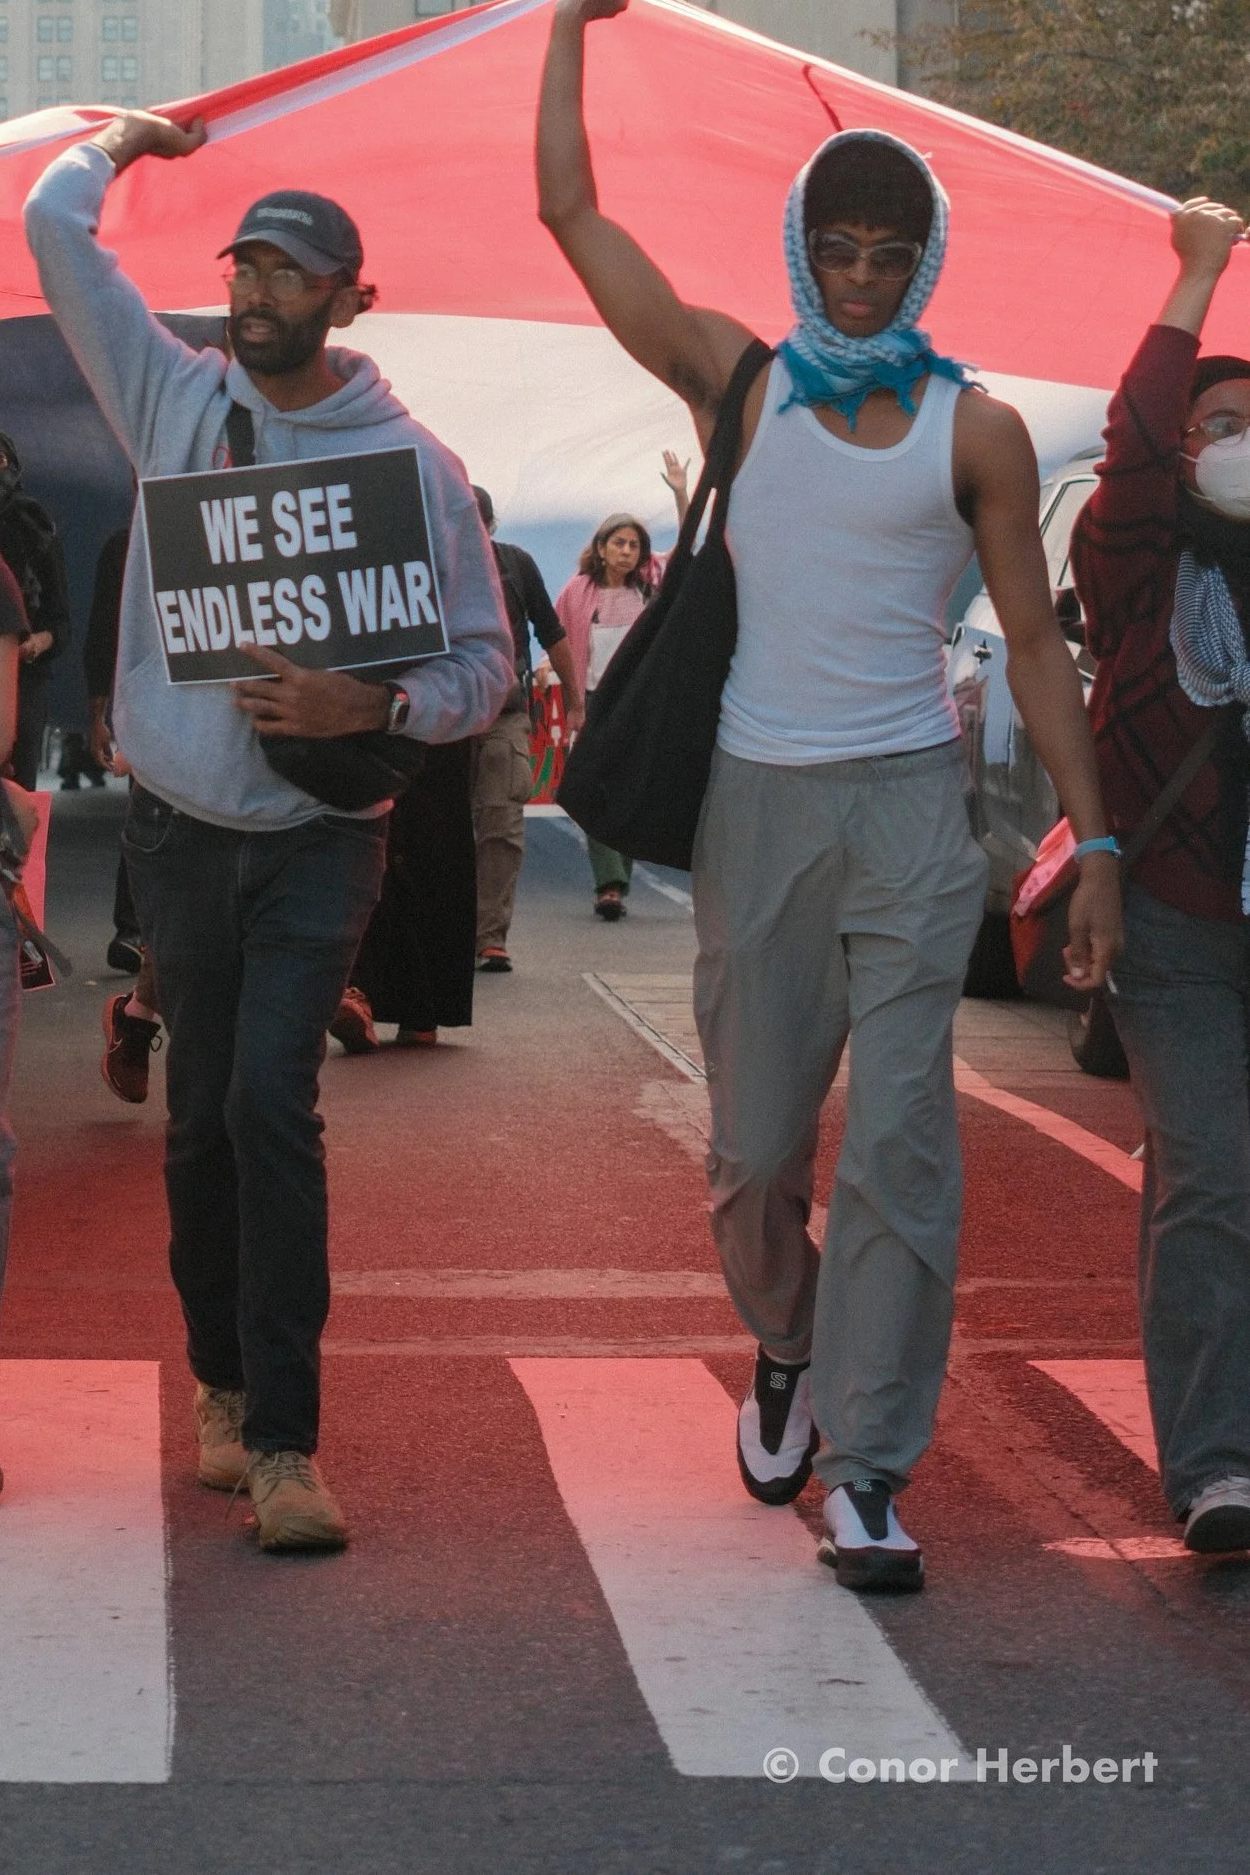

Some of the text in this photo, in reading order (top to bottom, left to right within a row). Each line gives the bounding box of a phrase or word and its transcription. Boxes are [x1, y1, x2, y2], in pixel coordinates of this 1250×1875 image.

[200, 483, 358, 564] WE SEE
[156, 560, 439, 654] ENDLESS WAR
